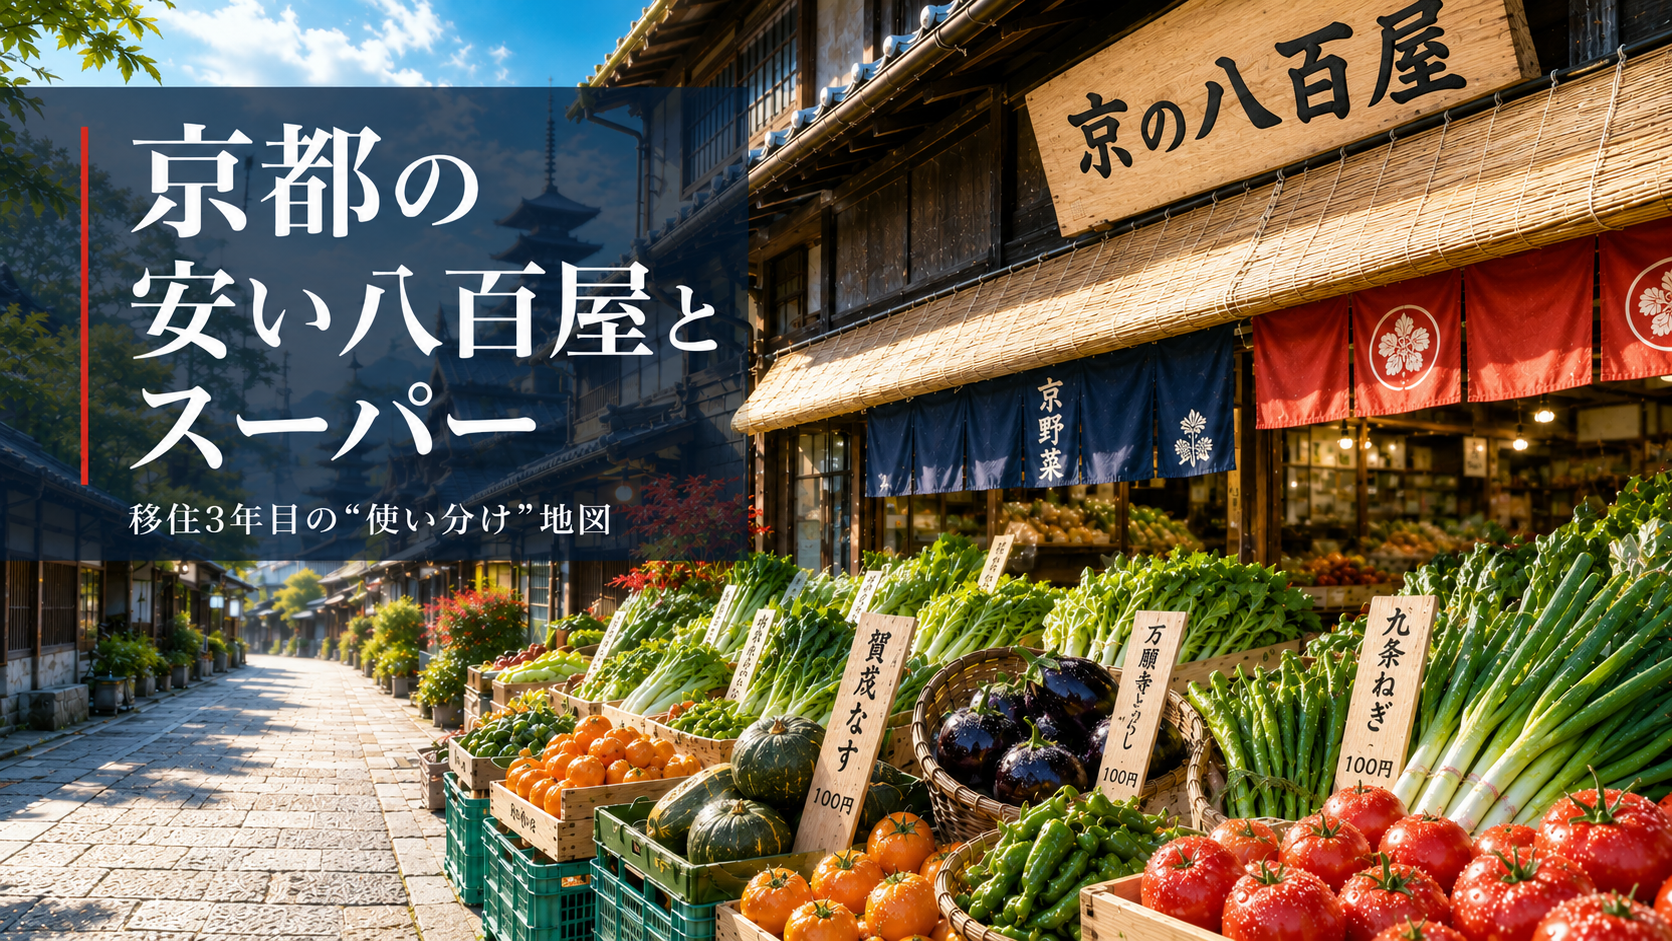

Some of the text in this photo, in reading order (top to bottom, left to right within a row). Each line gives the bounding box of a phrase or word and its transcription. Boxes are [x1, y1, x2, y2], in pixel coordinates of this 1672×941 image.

[1067, 0, 1467, 179] 京の八百屋
[1037, 377, 1066, 482] 京野菜
[837, 628, 893, 773] 賀茂なす
[1366, 607, 1411, 732] 九条ねぎ
[812, 787, 855, 816] 100円
[1103, 767, 1139, 789] 100円
[1346, 755, 1394, 779] 100円
